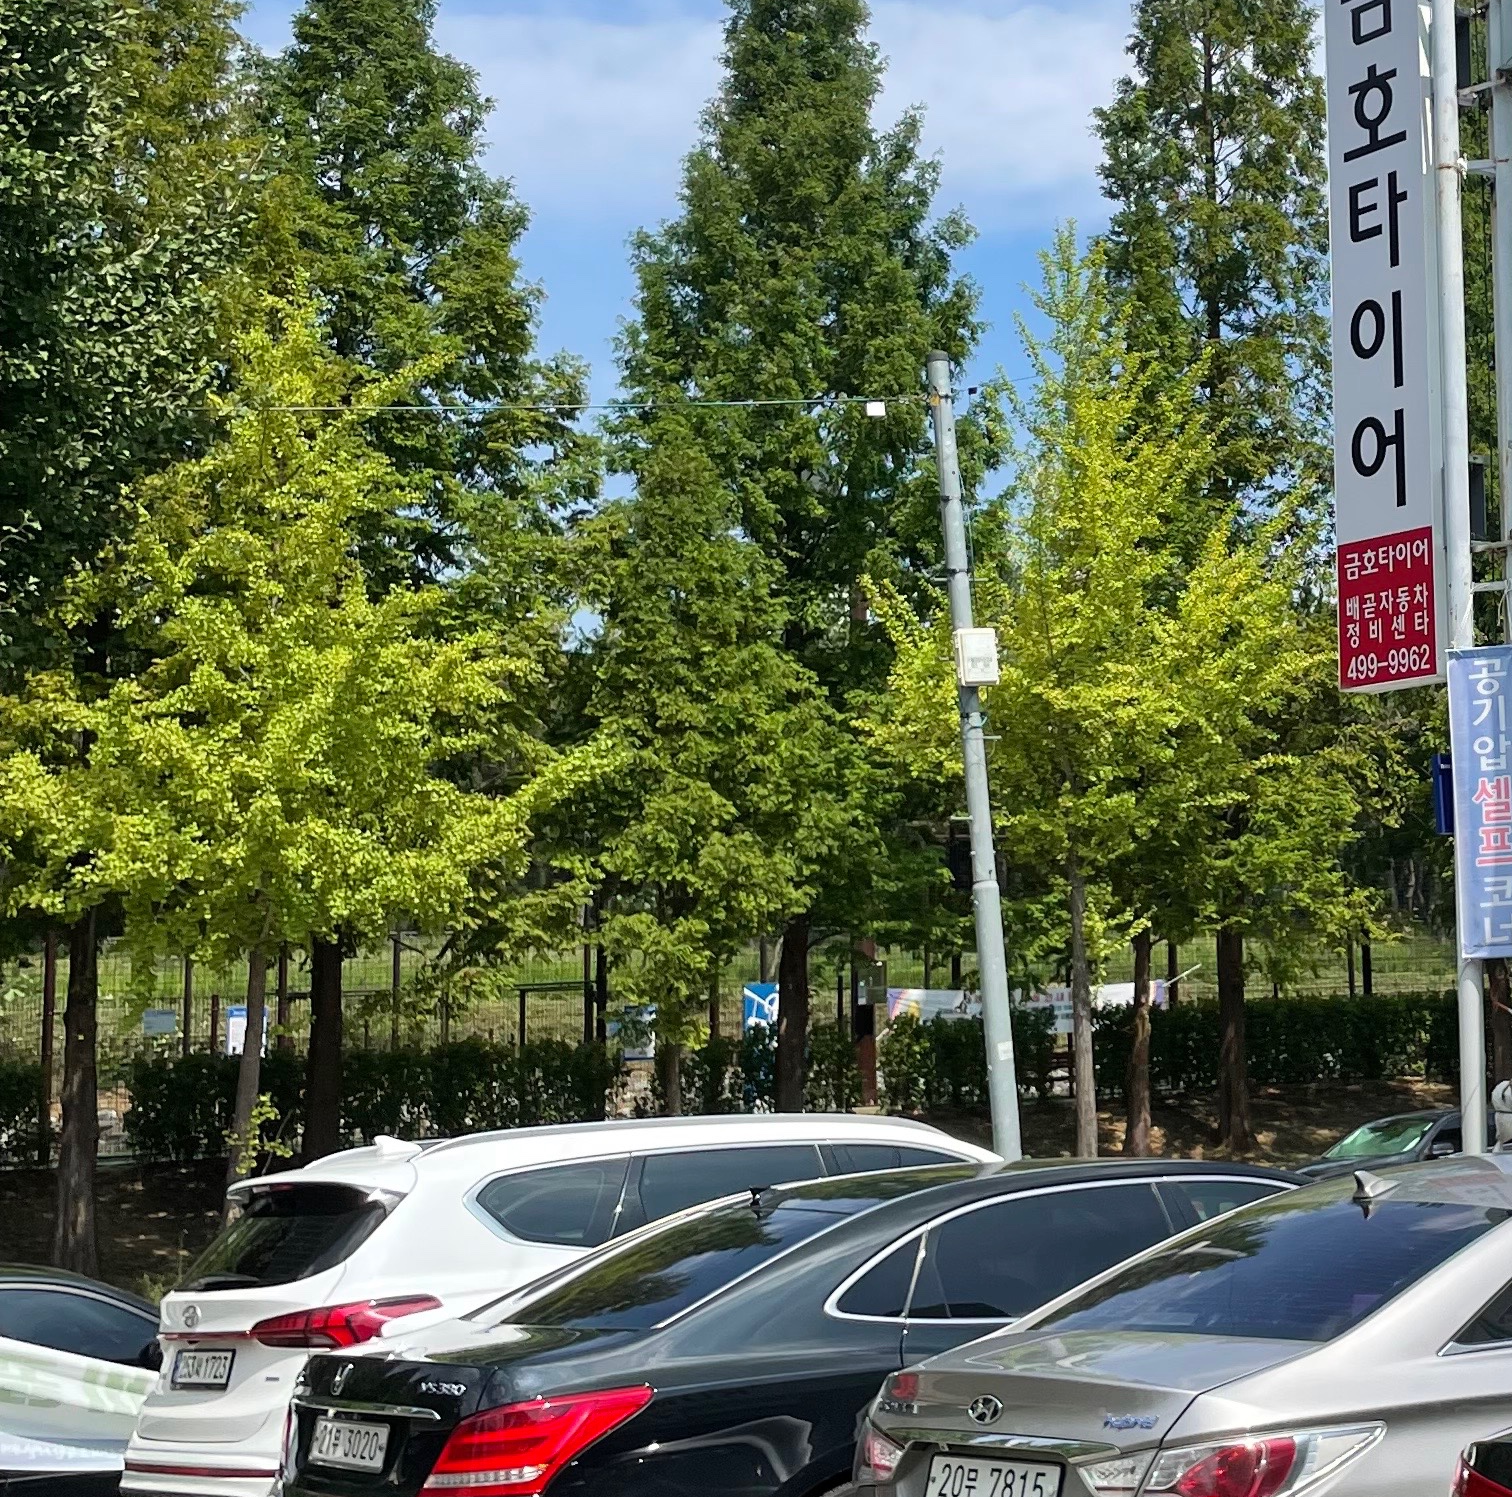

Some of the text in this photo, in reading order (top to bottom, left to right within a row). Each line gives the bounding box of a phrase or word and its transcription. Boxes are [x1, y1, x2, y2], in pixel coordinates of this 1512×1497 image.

[1344, 538, 1429, 580] 금호타이어
[1346, 582, 1429, 620] 배곧자동차
[1347, 644, 1431, 680] 499-9962
[343, 1429, 380, 1461] 3020
[938, 1463, 1048, 1497] 20무 7815
